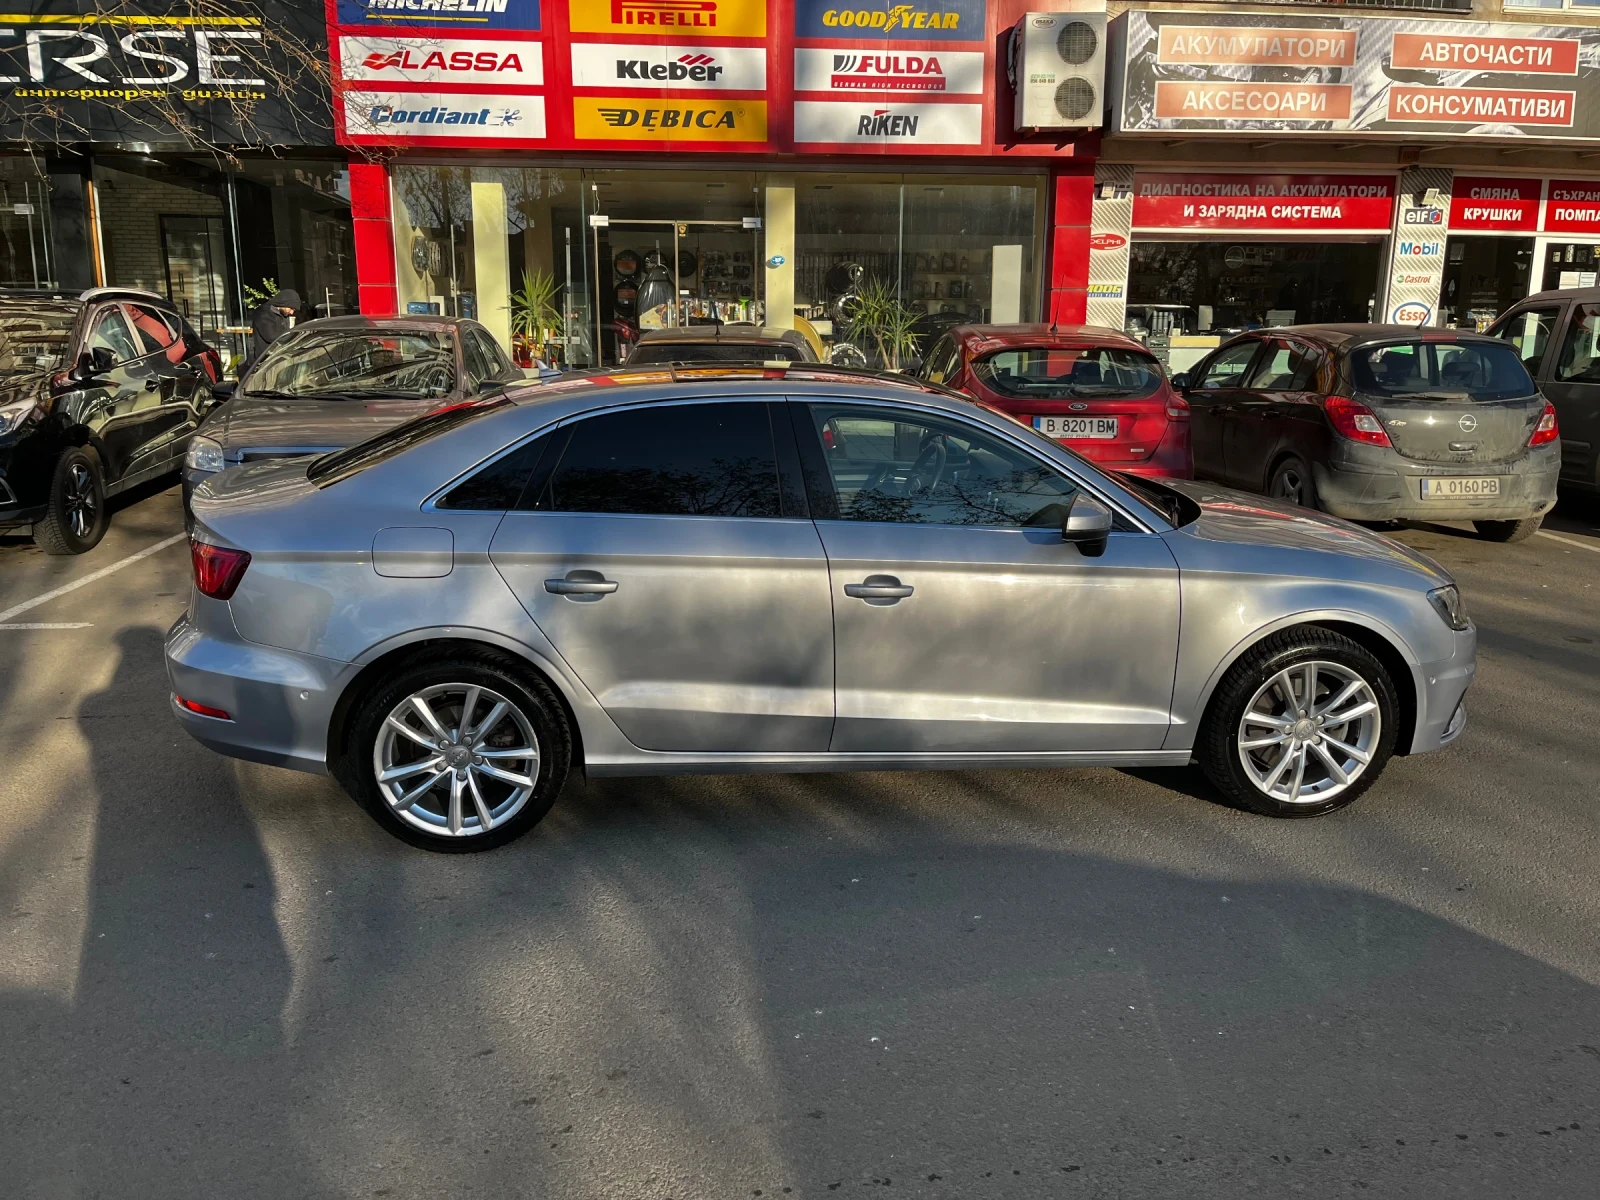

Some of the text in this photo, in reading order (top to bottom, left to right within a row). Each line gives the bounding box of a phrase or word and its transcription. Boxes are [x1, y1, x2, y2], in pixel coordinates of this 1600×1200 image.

[611, 0, 717, 27] PIRELLI
[1170, 34, 1346, 58] АКУМУЛАТОРИ
[1419, 41, 1553, 66] АВТОЧАСТИ
[400, 50, 524, 72] LASSA
[853, 55, 943, 74] FULDA
[616, 59, 723, 82] Kleber
[1182, 90, 1327, 112] АКСЕСОАРИ
[1395, 94, 1566, 119] КОНСУМАТИВИ
[369, 104, 491, 125] Cordiant
[1139, 181, 1388, 199] ДИАГНОСТИКА НА АКУМУЛАТОРИ
[1470, 187, 1520, 201] СМЯНА
[1183, 204, 1342, 220] И ЗАРЯДНА СИСТЕМА
[1405, 209, 1429, 223] elf
[1463, 207, 1523, 222] КРУШКИ
[1399, 241, 1439, 256] Mobil
[1404, 274, 1432, 284] Castrol
[1398, 309, 1426, 322] Esso
[1062, 419, 1094, 433] 8201
[1097, 419, 1115, 434] BM
[1434, 480, 1498, 494] A 0160 PB
